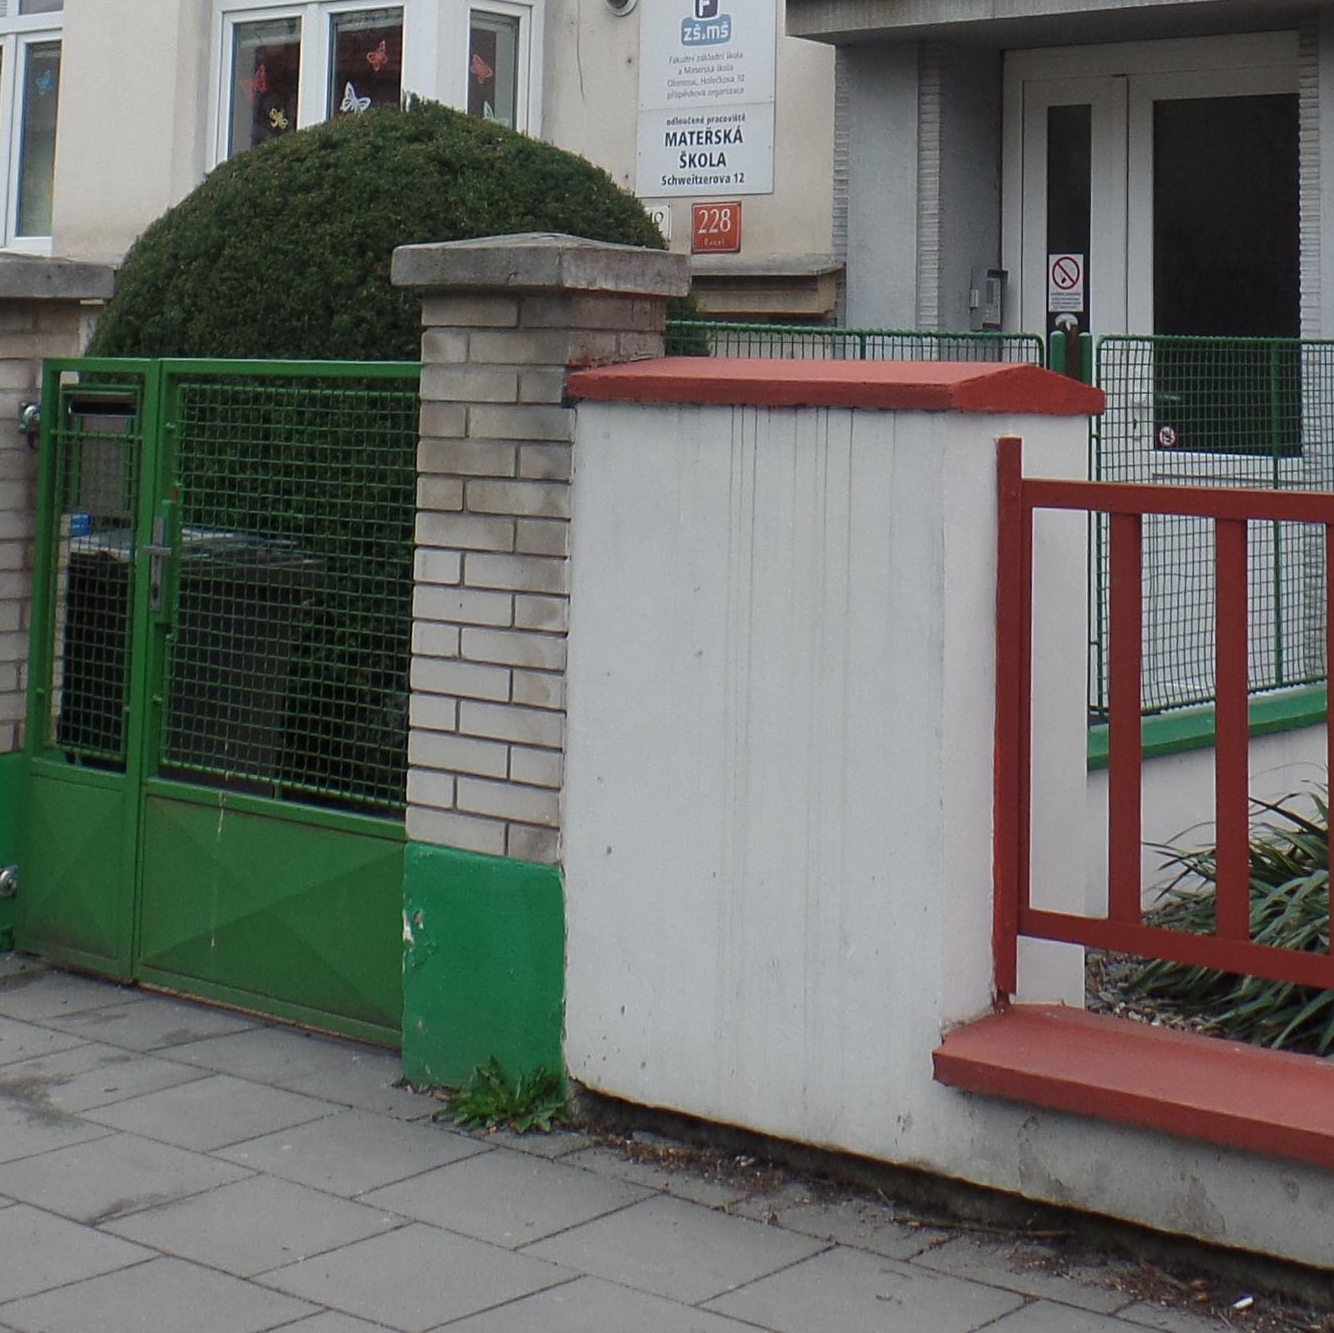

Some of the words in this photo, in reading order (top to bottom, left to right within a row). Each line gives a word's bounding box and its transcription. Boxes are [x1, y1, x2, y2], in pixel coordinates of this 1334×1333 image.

[665, 125, 744, 147] MATEŘSKÁ
[679, 150, 727, 169] ŠKOLA
[661, 174, 731, 186] Schweitzerova
[734, 172, 745, 184] 12
[698, 208, 732, 235] 228
